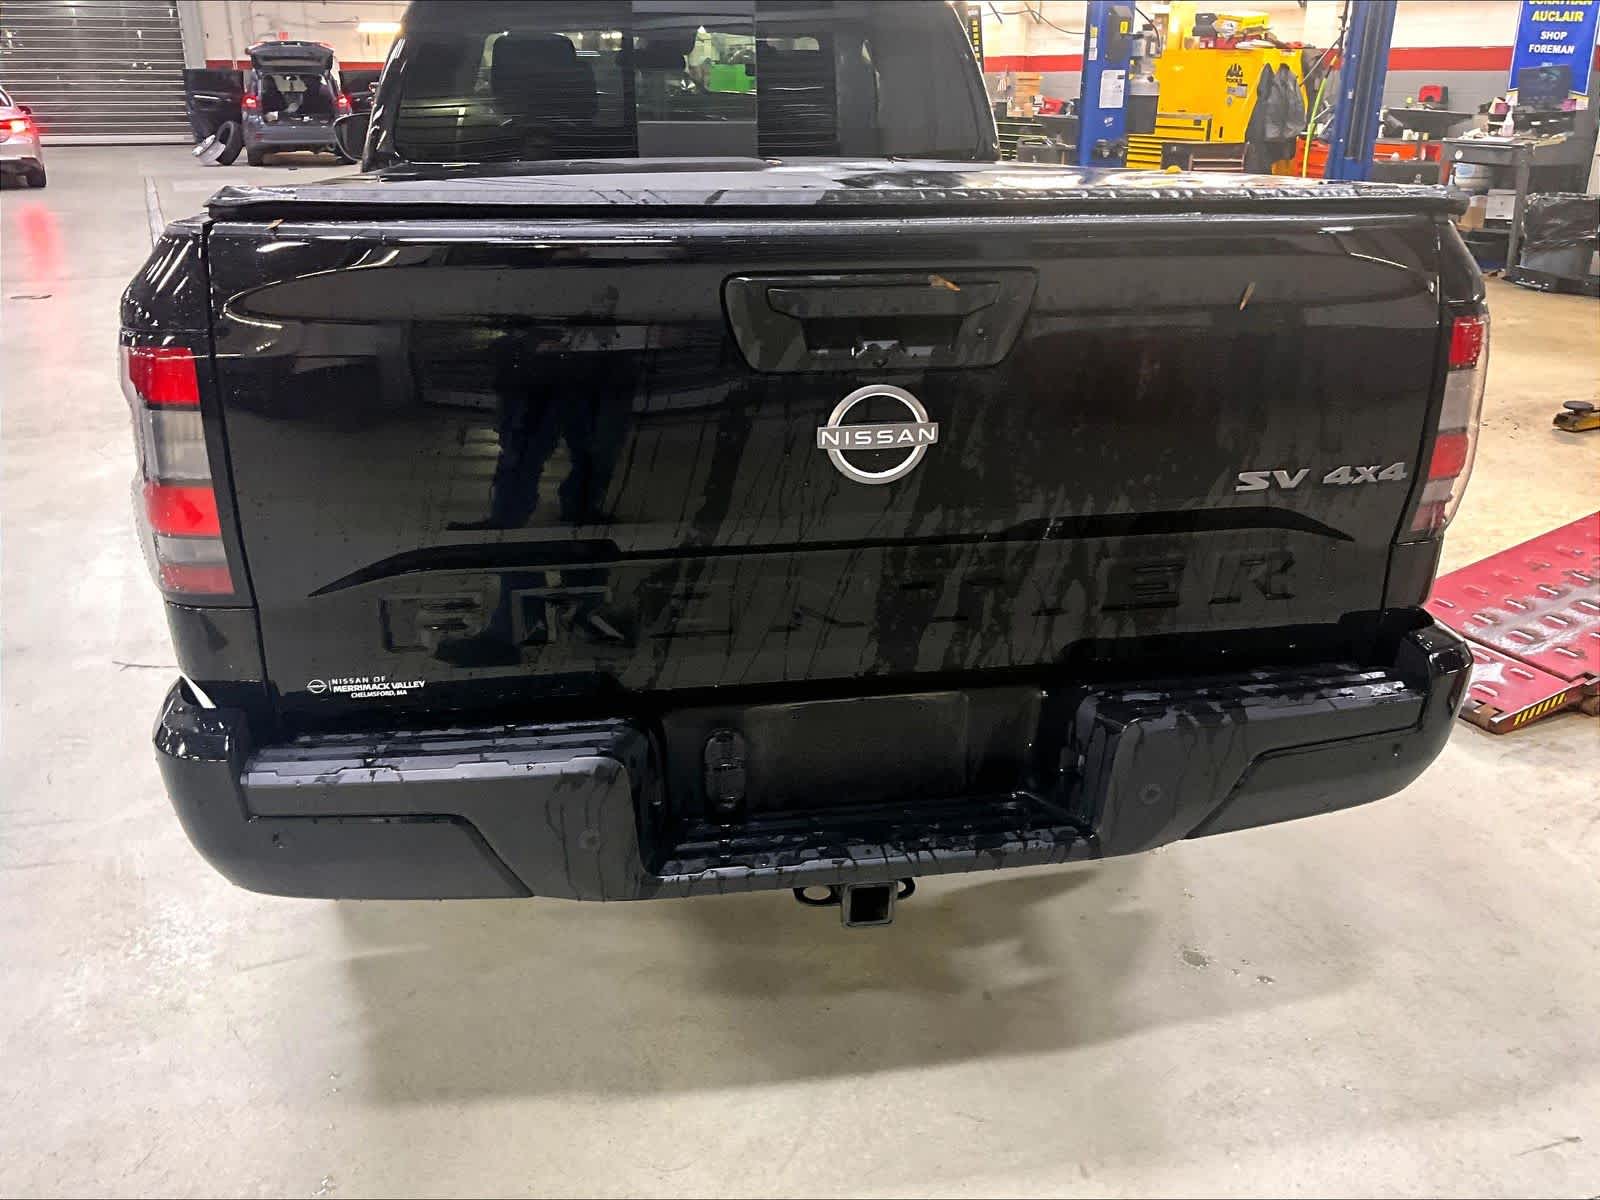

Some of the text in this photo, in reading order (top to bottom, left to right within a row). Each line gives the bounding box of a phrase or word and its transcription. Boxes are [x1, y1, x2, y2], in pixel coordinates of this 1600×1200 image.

[1531, 10, 1585, 22] AUCLAIR
[1540, 31, 1568, 41] SHOP
[1528, 43, 1575, 54] FOREMAN
[821, 426, 936, 446] NISSAN
[1235, 468, 1311, 492] SV
[331, 675, 386, 685] NISSAN OF
[333, 680, 425, 693] MERRIMACK VALLEY
